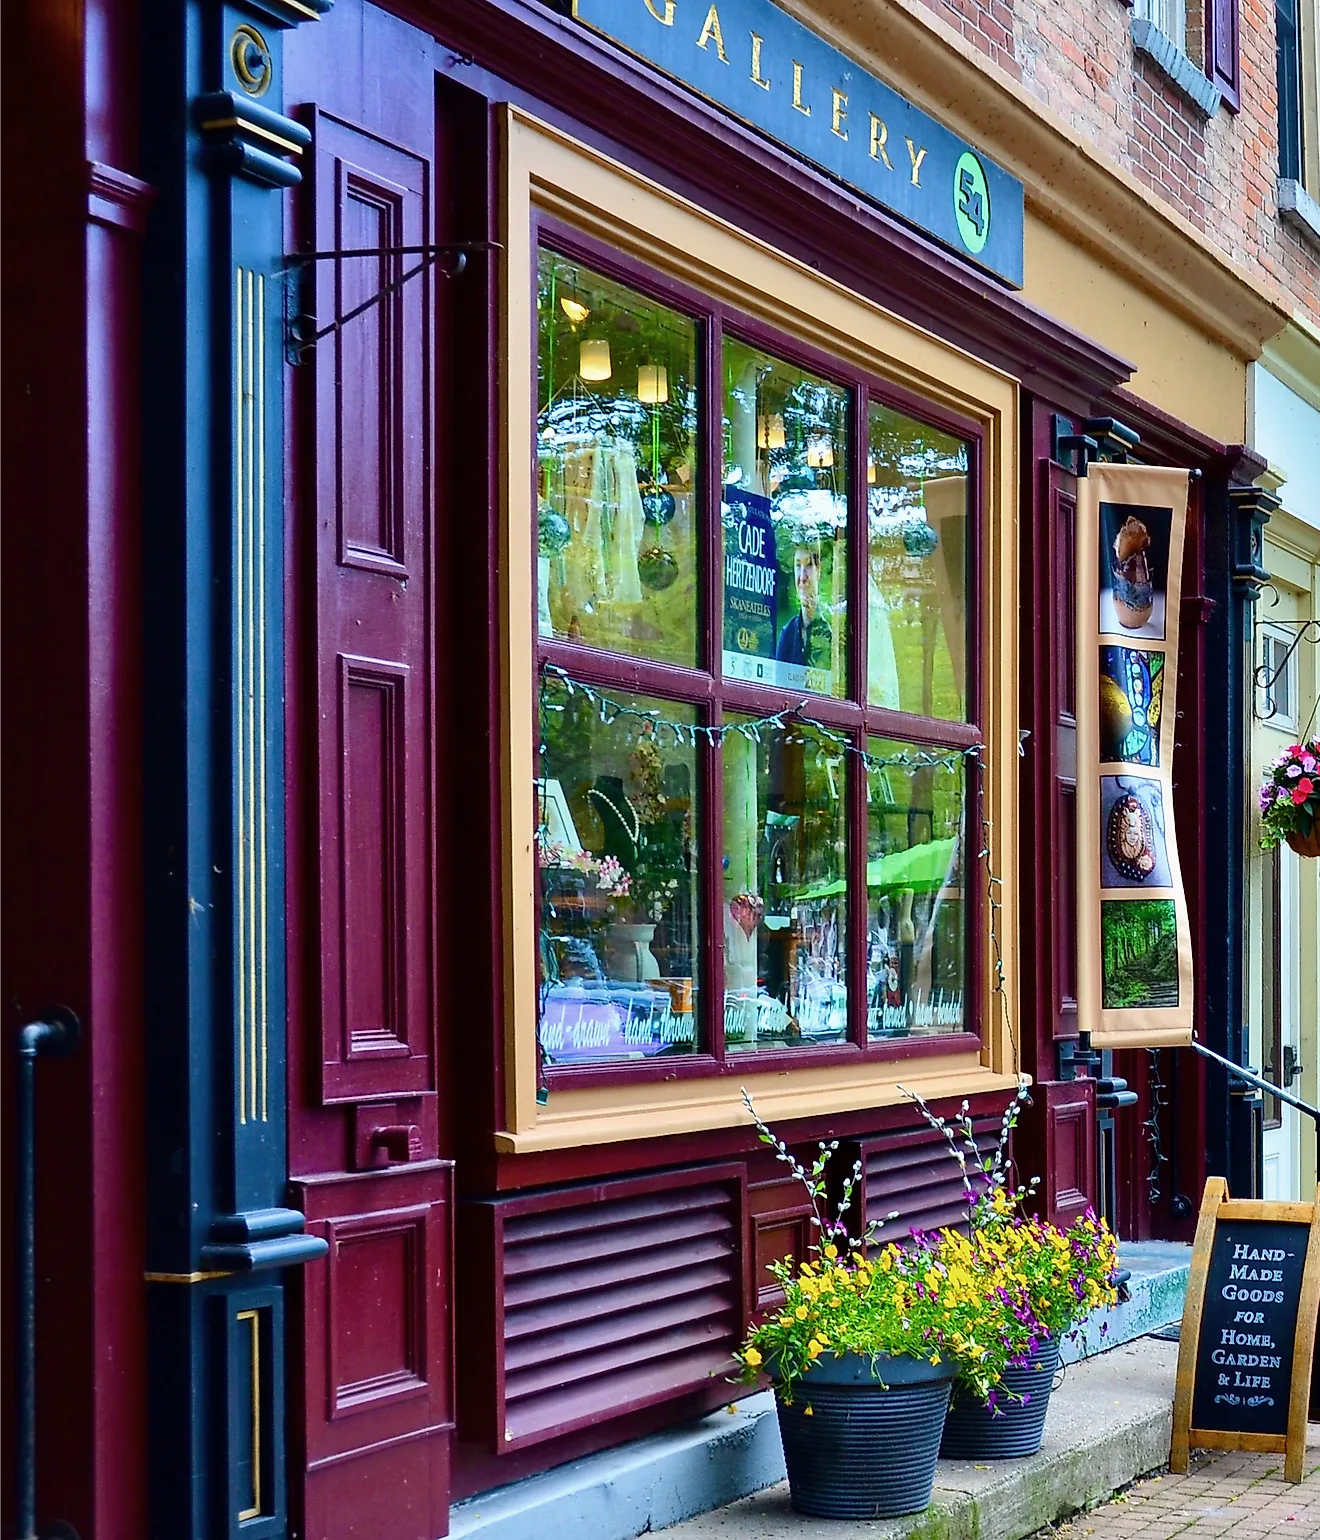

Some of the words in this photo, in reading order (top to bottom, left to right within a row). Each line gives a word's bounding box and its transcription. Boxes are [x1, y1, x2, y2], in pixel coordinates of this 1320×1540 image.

[959, 168, 985, 237] 54
[738, 520, 767, 559] CADE
[725, 554, 777, 598] HERTZENDORF
[729, 596, 772, 617] SKANEATELES
[1232, 1243, 1295, 1262] HAND-
[1228, 1263, 1284, 1283] MADE
[1221, 1284, 1285, 1304] GOODS
[1233, 1310, 1265, 1324] FOR
[1219, 1328, 1276, 1350] HOME,
[1211, 1349, 1282, 1369] GARDEN
[1217, 1373, 1230, 1386] &
[1233, 1371, 1271, 1389] LIFE
